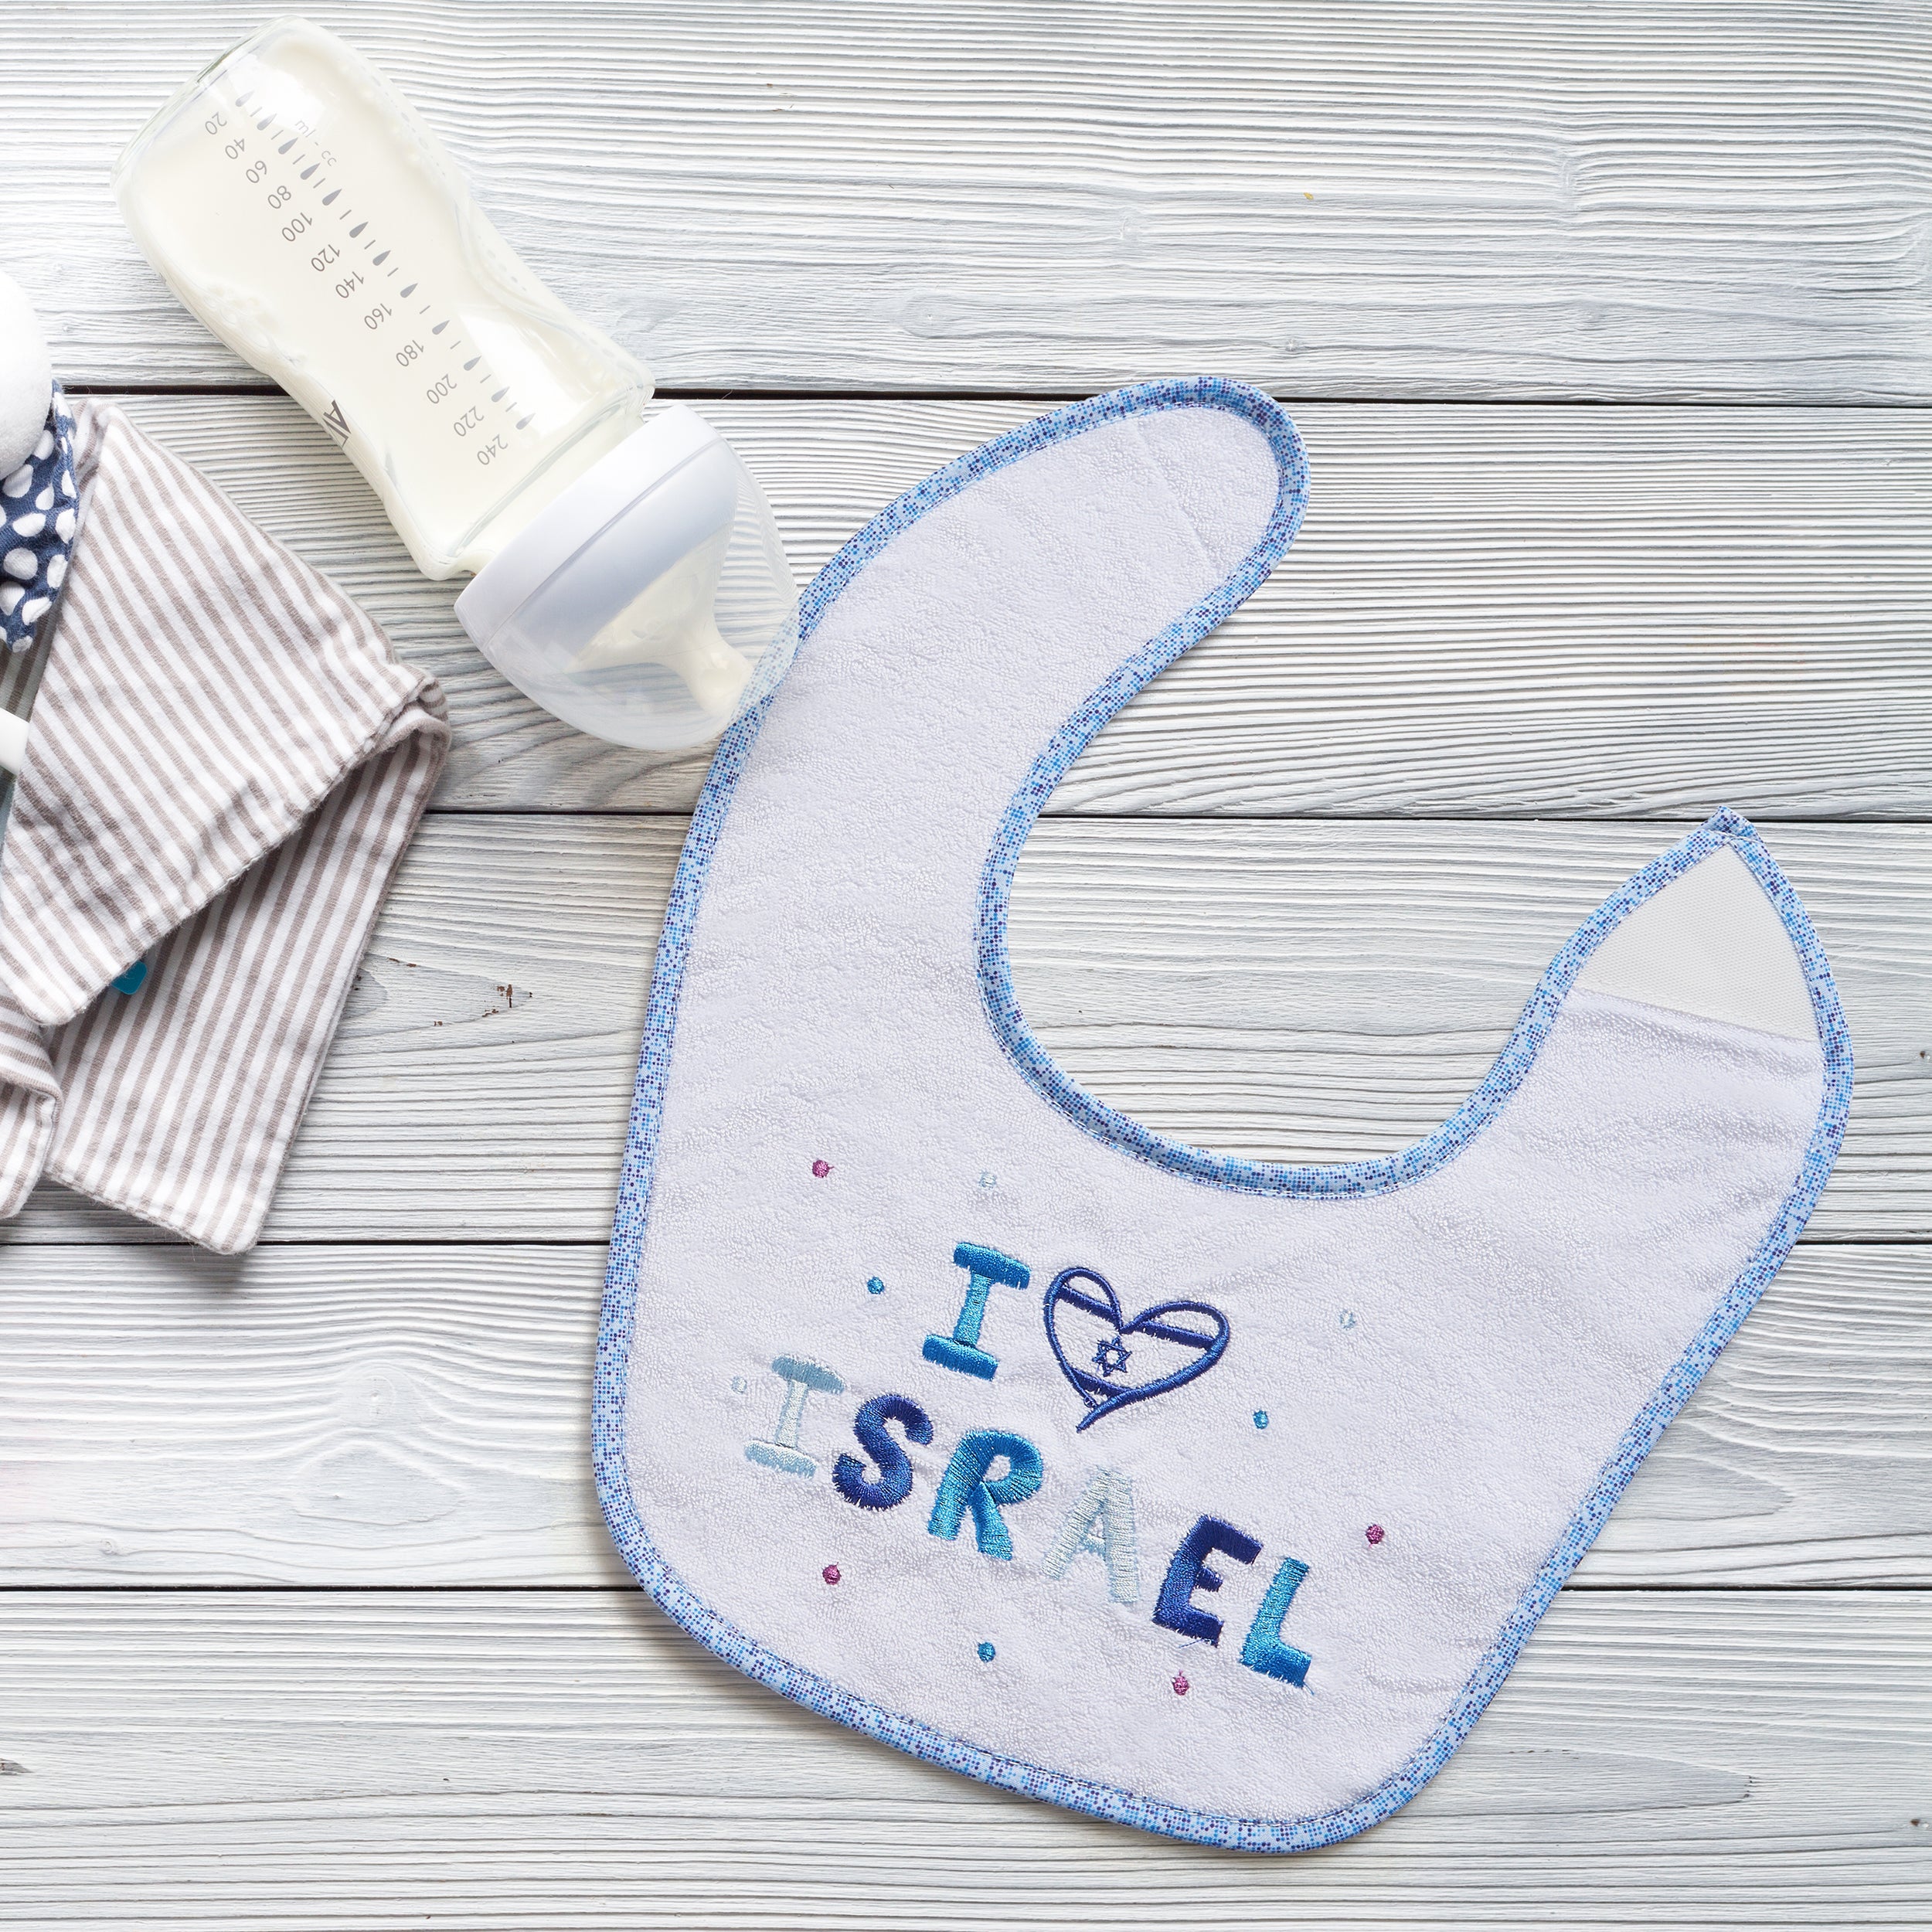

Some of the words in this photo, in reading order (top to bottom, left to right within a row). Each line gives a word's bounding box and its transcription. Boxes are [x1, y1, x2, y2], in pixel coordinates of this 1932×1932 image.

[205, 112, 227, 134] 20
[225, 138, 244, 159] 40
[294, 120, 316, 138] ml
[321, 150, 337, 167] cc
[246, 161, 267, 183] 60
[267, 185, 291, 209] 80
[282, 213, 312, 241] 100
[311, 244, 340, 271] 120
[335, 271, 364, 298] 140
[364, 304, 392, 329] 160
[396, 340, 423, 366] 180
[427, 374, 457, 403] 200
[454, 406, 484, 437] 220
[477, 434, 508, 465] 240
[921, 1241, 1031, 1381] I
[743, 1352, 1314, 1688] ISRAEL
